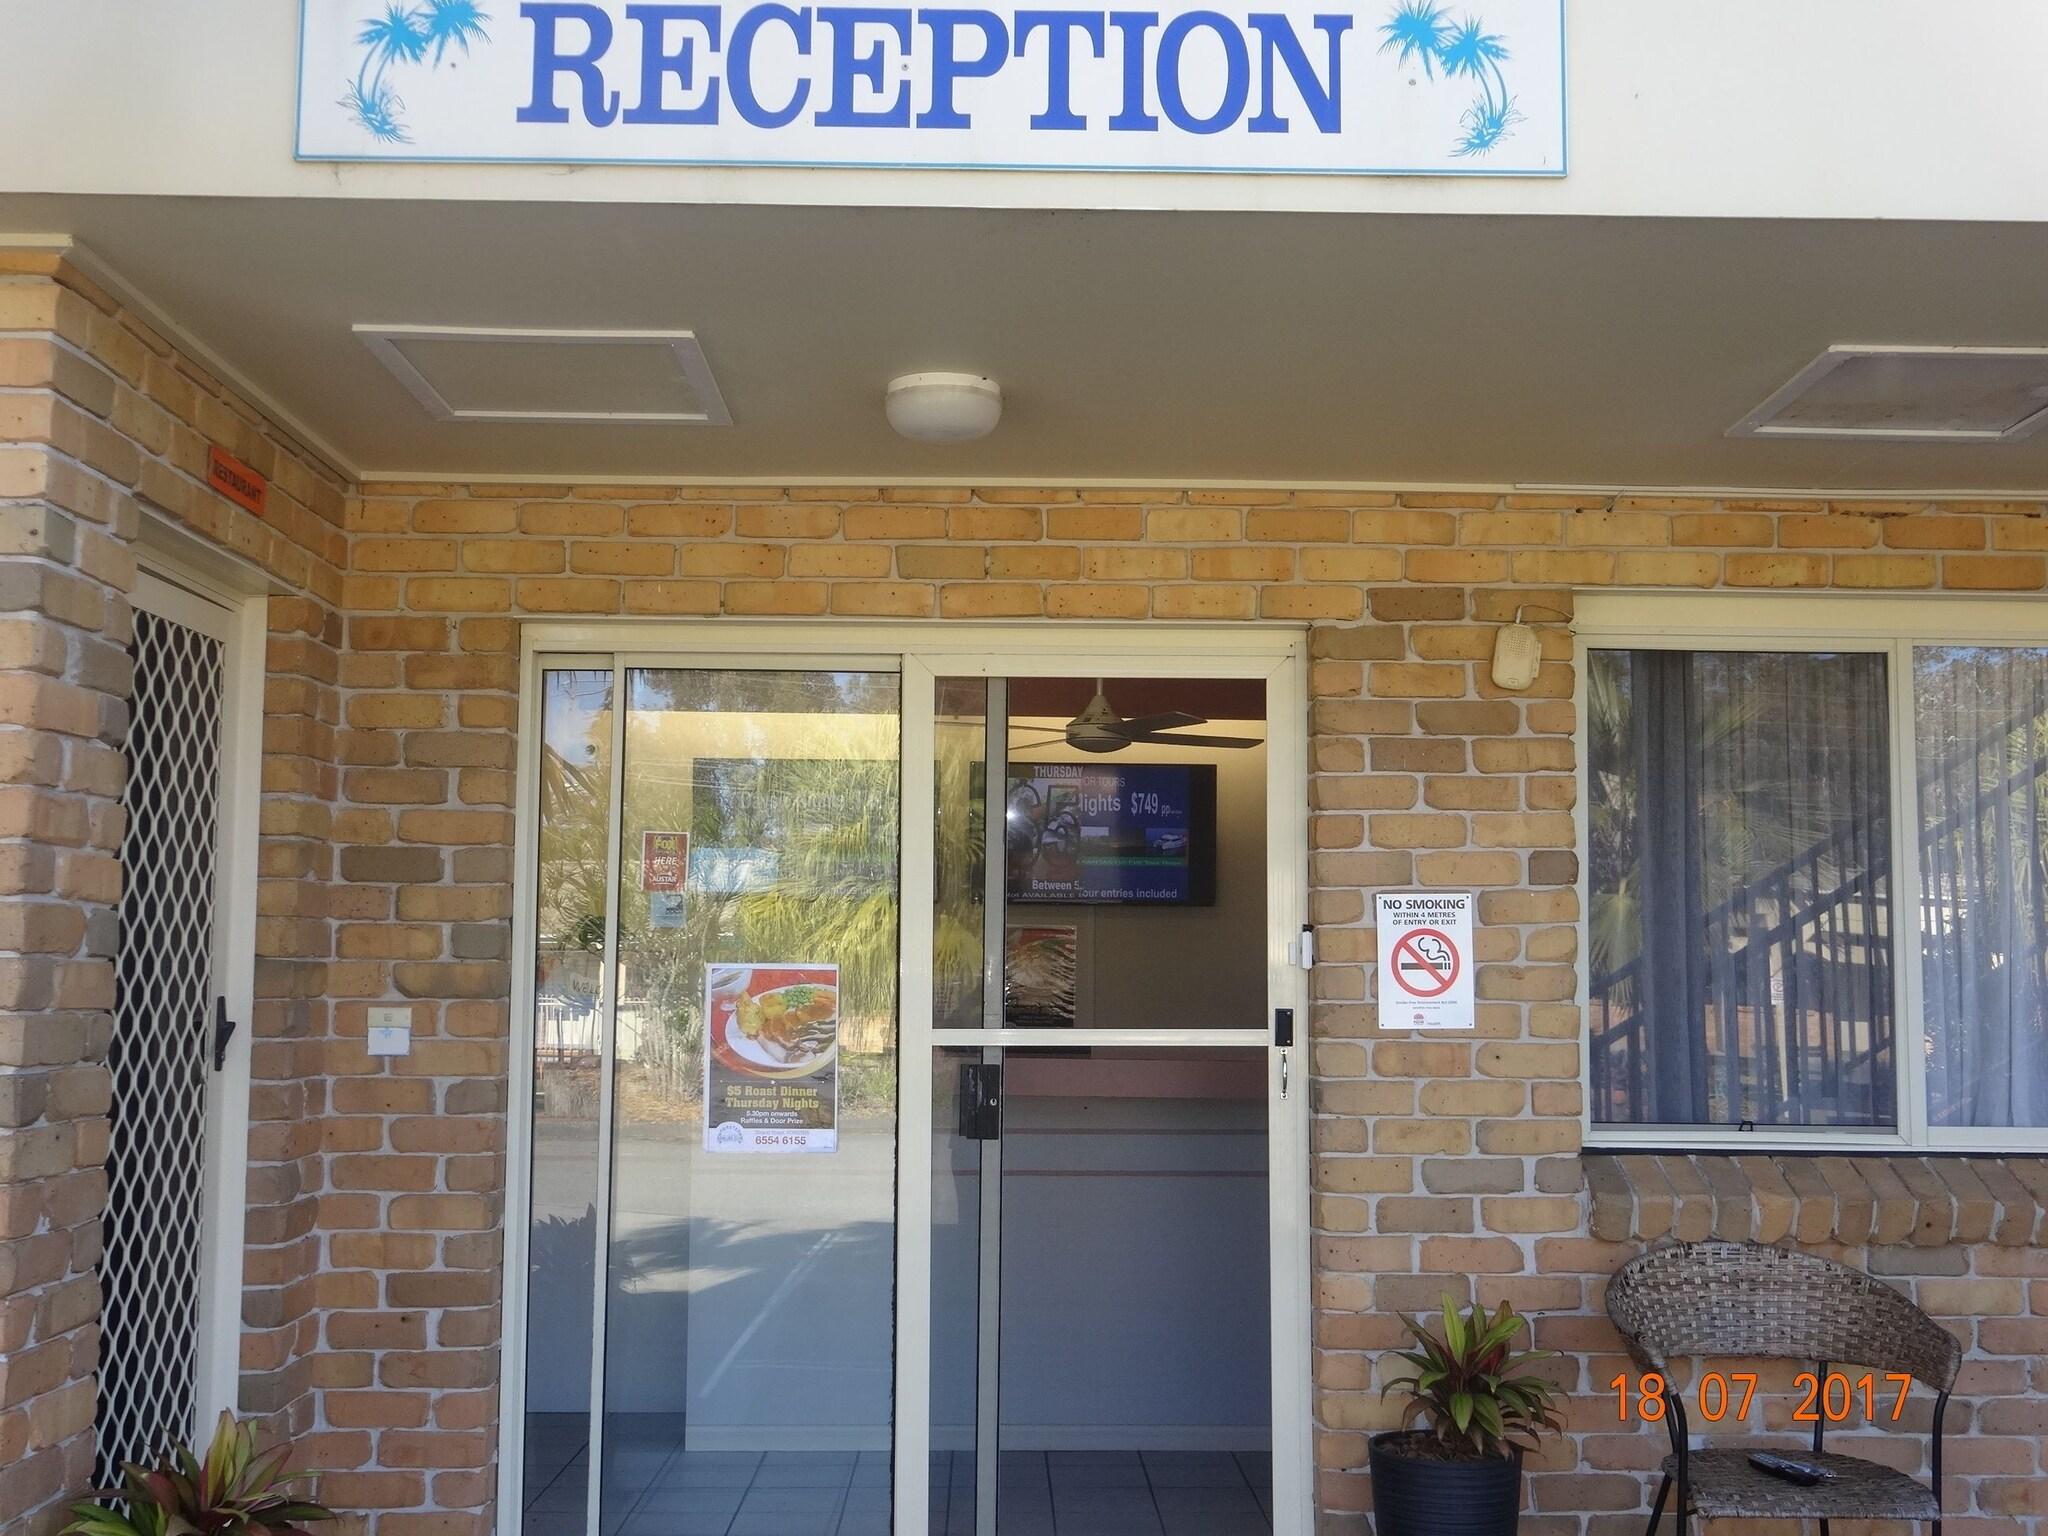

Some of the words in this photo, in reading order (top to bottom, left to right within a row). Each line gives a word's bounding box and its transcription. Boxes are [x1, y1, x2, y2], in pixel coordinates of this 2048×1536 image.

[516, 3, 1353, 134] RECEPTION
[1034, 766, 1083, 777] THURSDAY
[1131, 792, 1158, 817] $749
[654, 857, 677, 865] HERE
[1032, 880, 1072, 890] Between
[1101, 888, 1133, 898] entries
[1136, 888, 1177, 898] included
[1383, 899, 1402, 909] NO
[1405, 899, 1465, 909] SMOKING
[727, 1085, 741, 1097] $5
[745, 1086, 777, 1096] Roast
[781, 1086, 817, 1097] Dinner
[725, 1098, 779, 1110] Thursday
[783, 1099, 819, 1110] Nights
[755, 1136, 780, 1145] 6554
[782, 1136, 807, 1145] 6155
